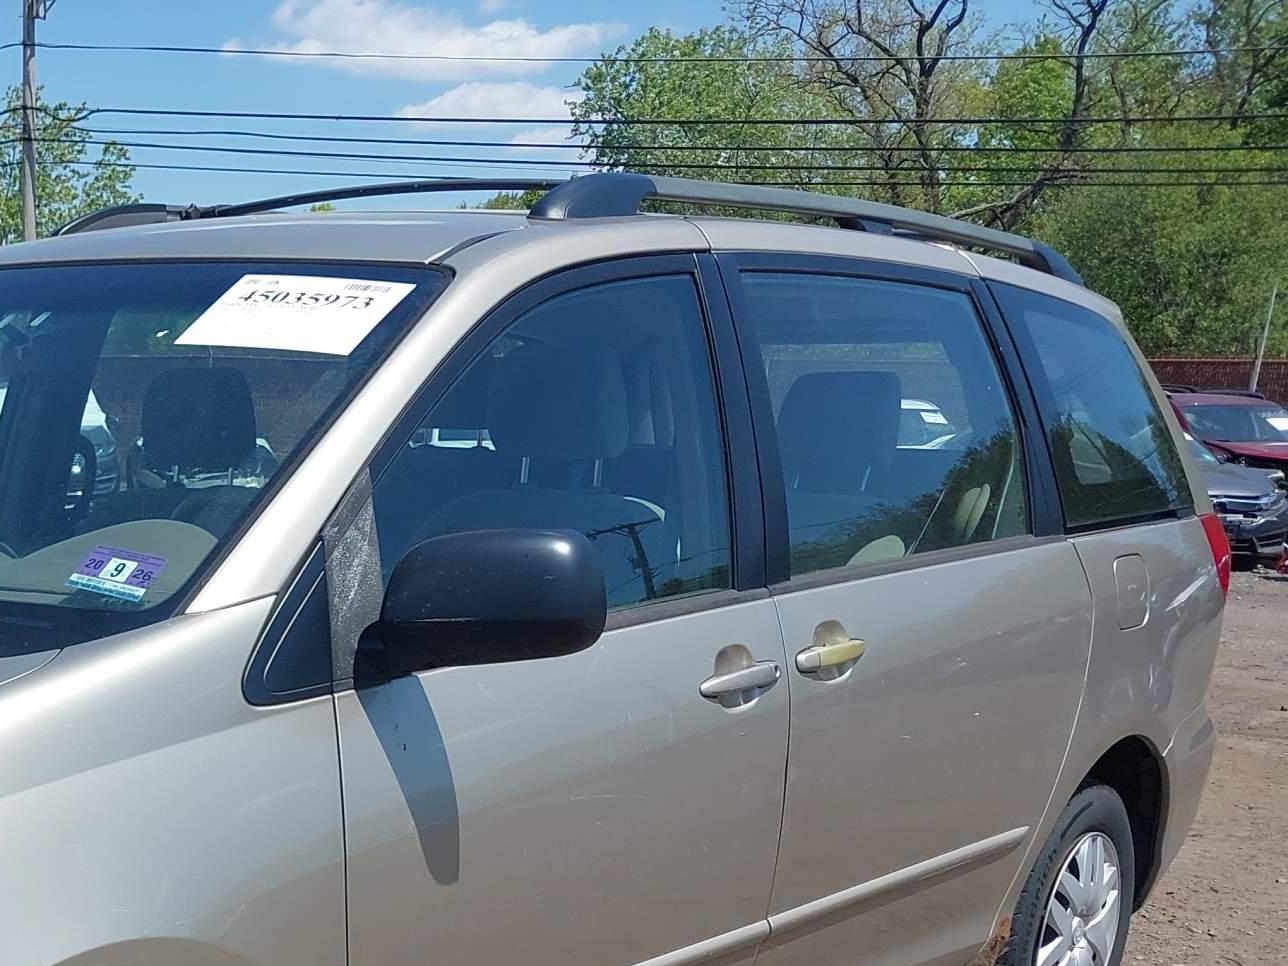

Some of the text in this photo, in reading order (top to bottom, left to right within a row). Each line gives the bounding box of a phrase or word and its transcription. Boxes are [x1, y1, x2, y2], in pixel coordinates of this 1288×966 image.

[238, 289, 375, 310] 45035973
[84, 558, 105, 570] 20
[110, 563, 126, 578] 9
[132, 569, 153, 581] 26
